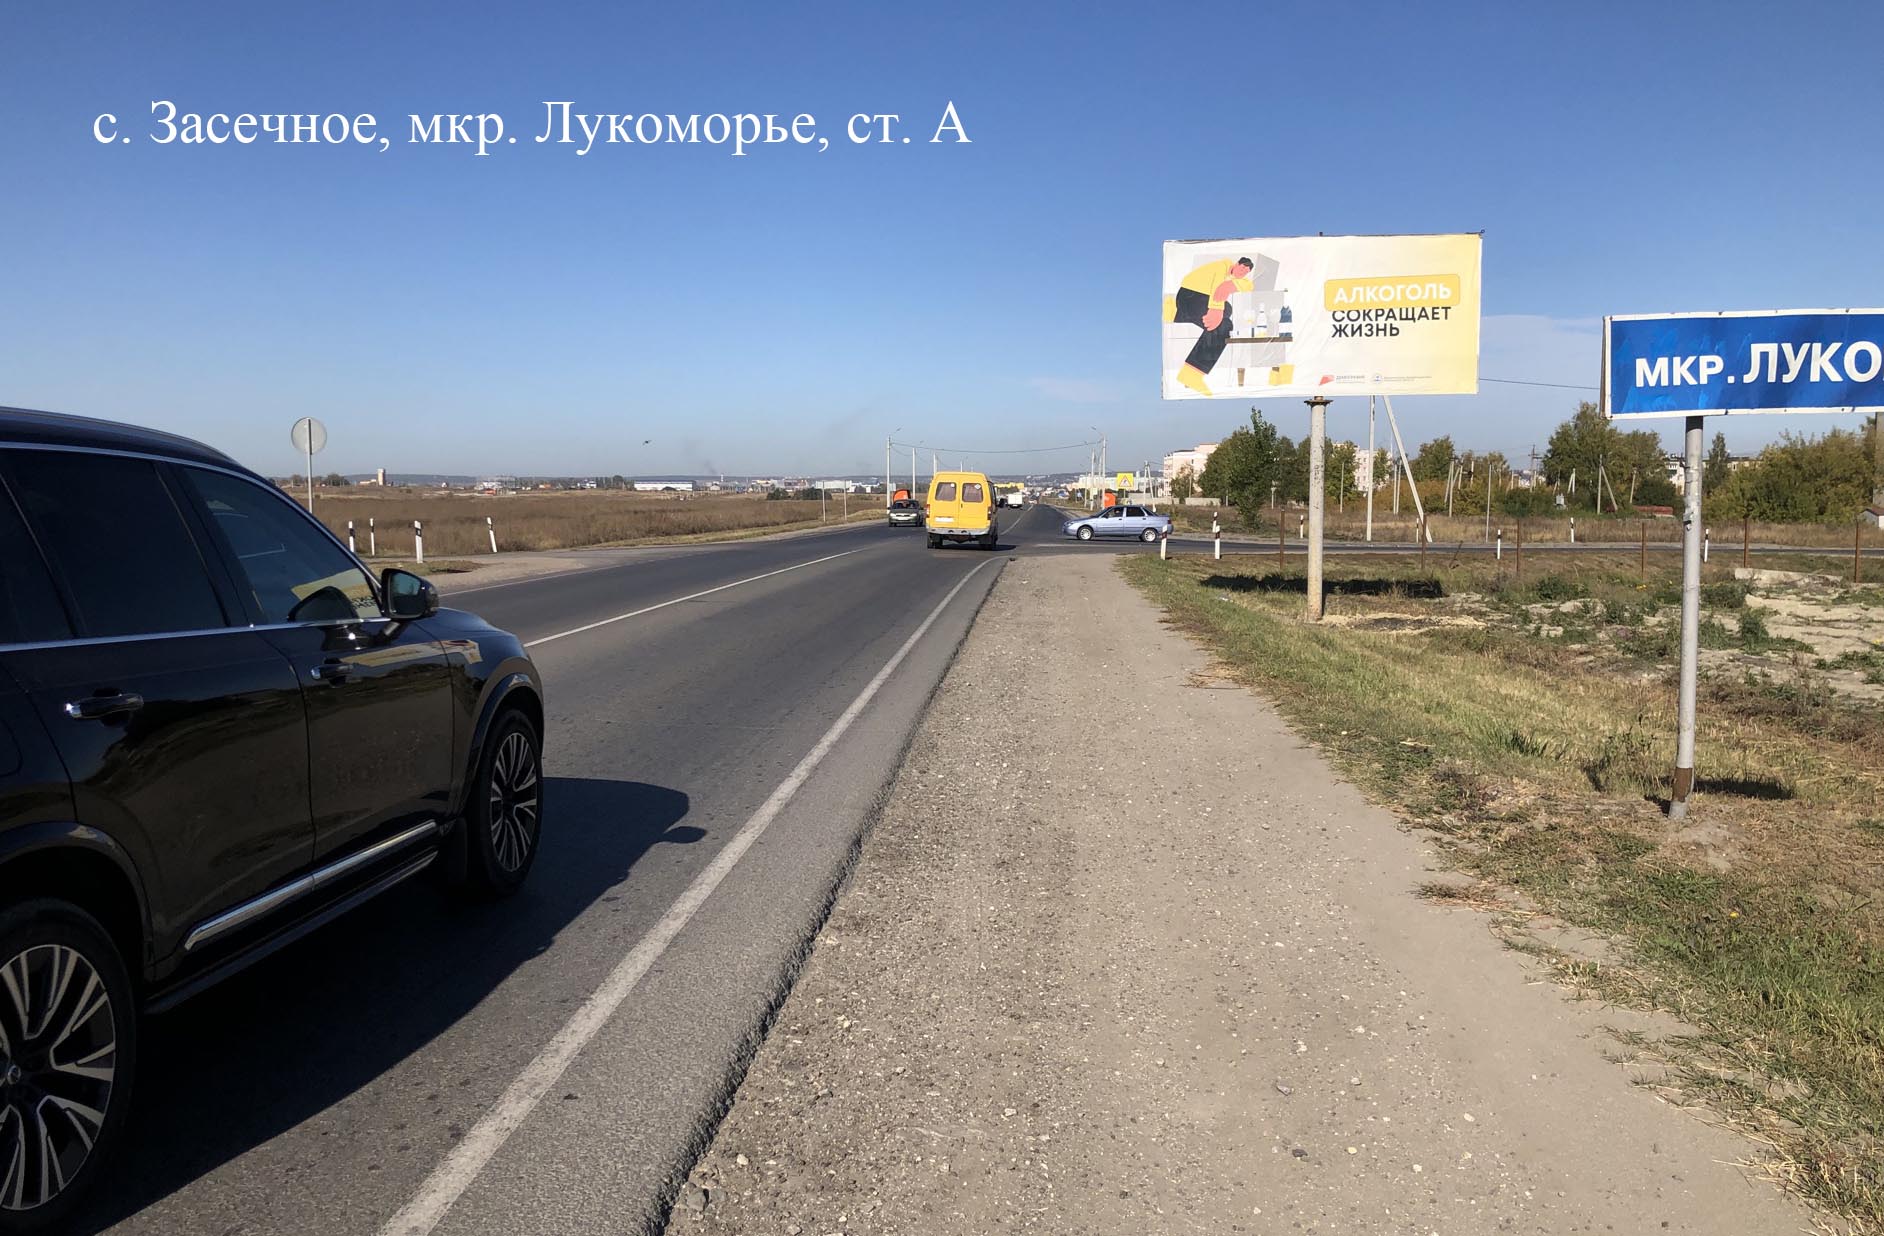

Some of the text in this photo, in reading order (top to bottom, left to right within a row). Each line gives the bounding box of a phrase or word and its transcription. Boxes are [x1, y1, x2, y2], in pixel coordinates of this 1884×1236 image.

[1333, 282, 1452, 304] АЛКОГОЛЬ
[1331, 306, 1452, 323] СОКРАЩАЕТ
[1331, 322, 1400, 338] ЖИЗНЬ
[1743, 340, 1884, 384] ЛУКО
